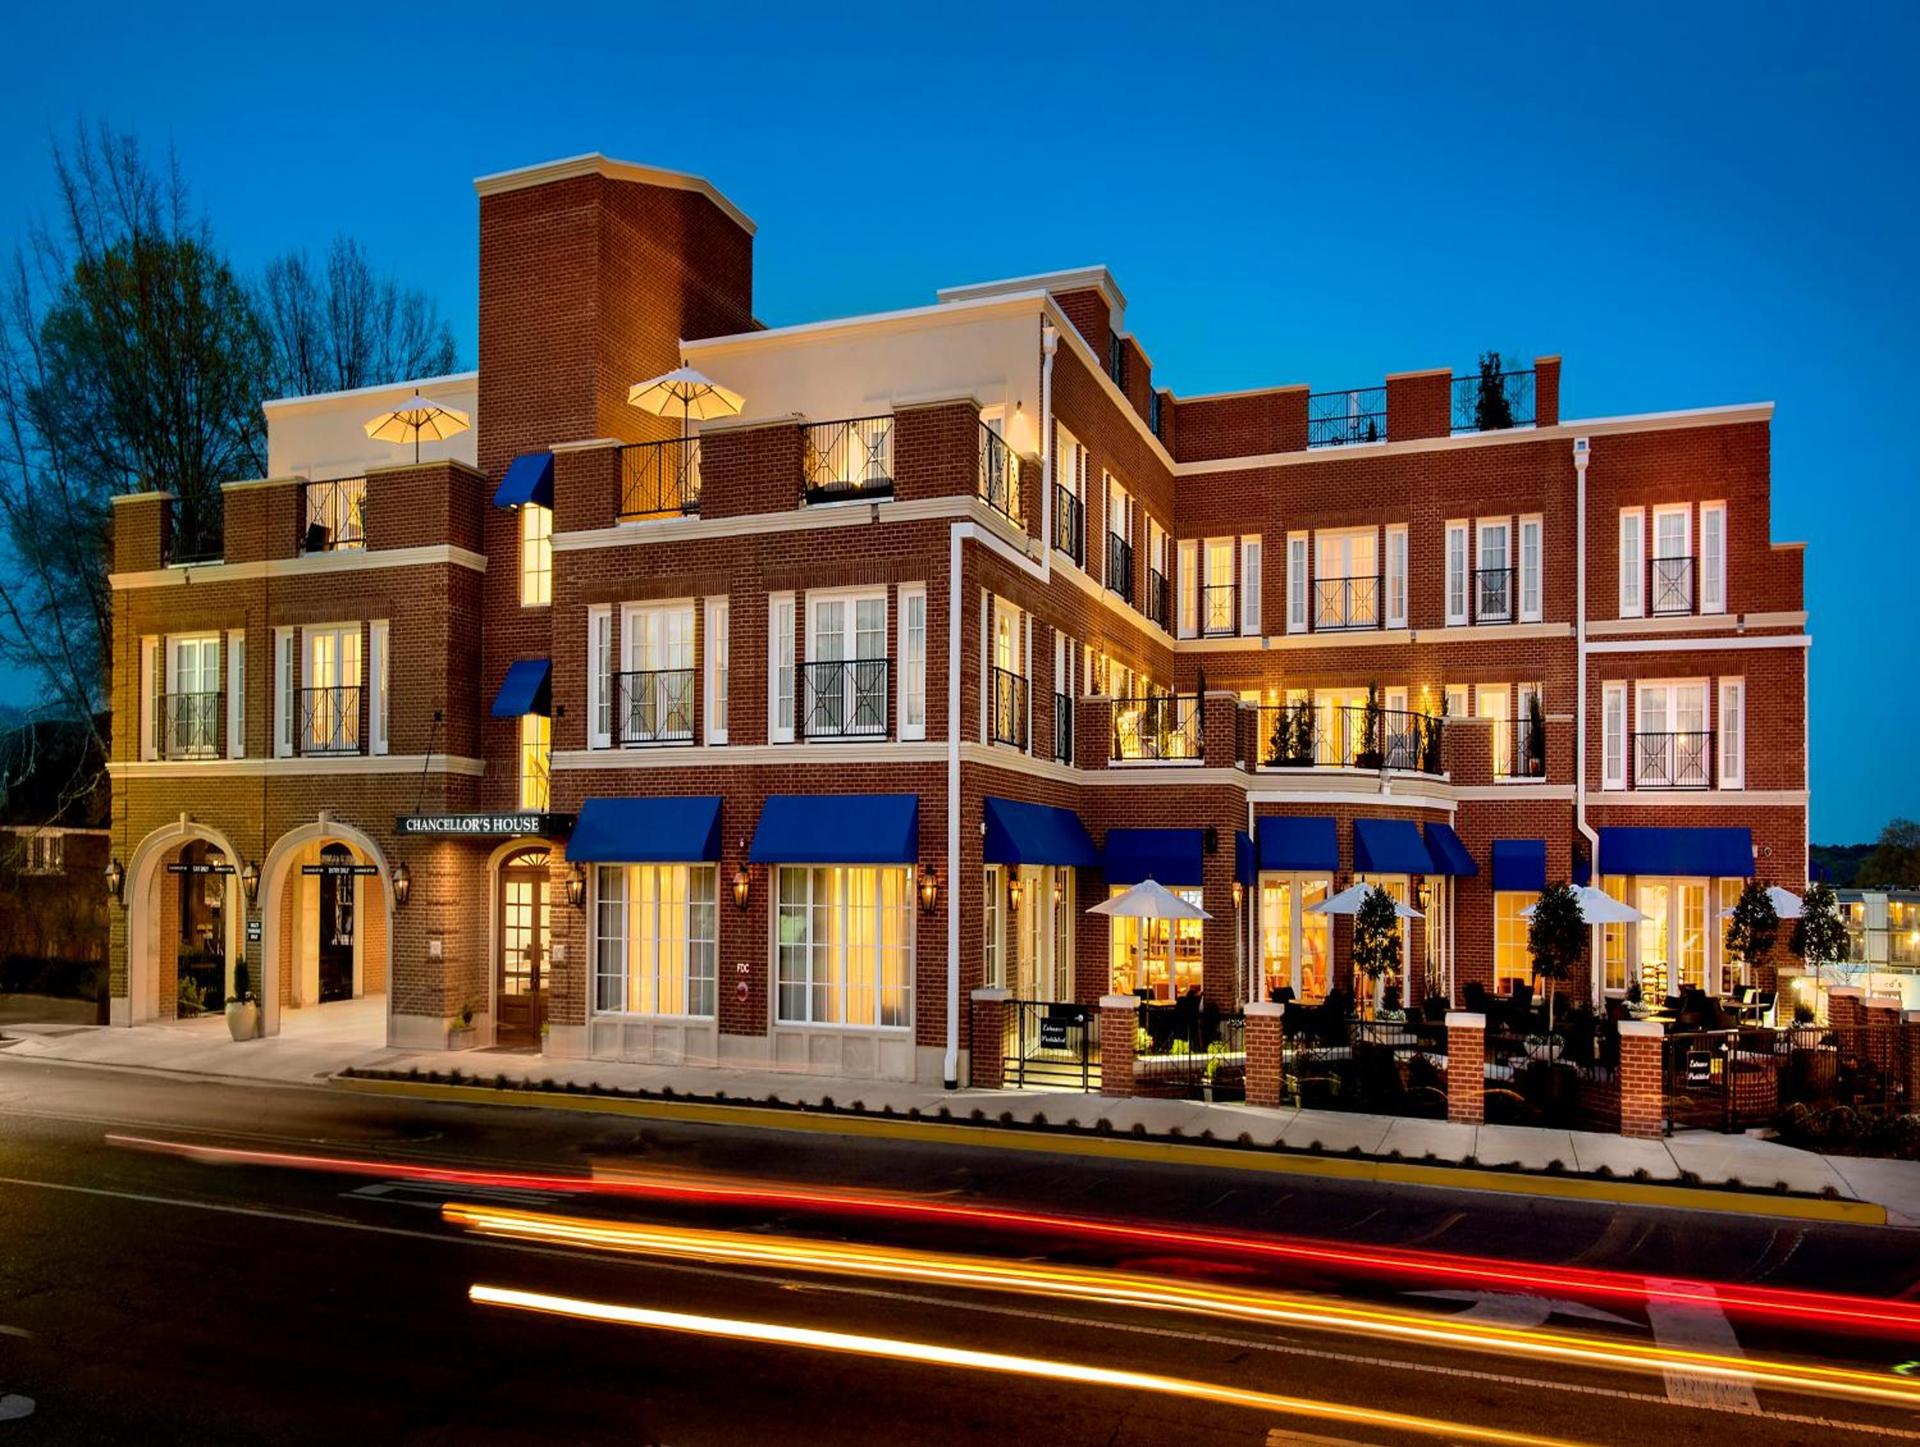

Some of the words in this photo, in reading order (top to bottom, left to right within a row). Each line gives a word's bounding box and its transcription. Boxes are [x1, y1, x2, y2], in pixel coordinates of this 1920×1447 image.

[406, 818, 490, 832] CHANCELLOR'S
[493, 817, 540, 832] HOUSE
[736, 963, 750, 974] FDC
